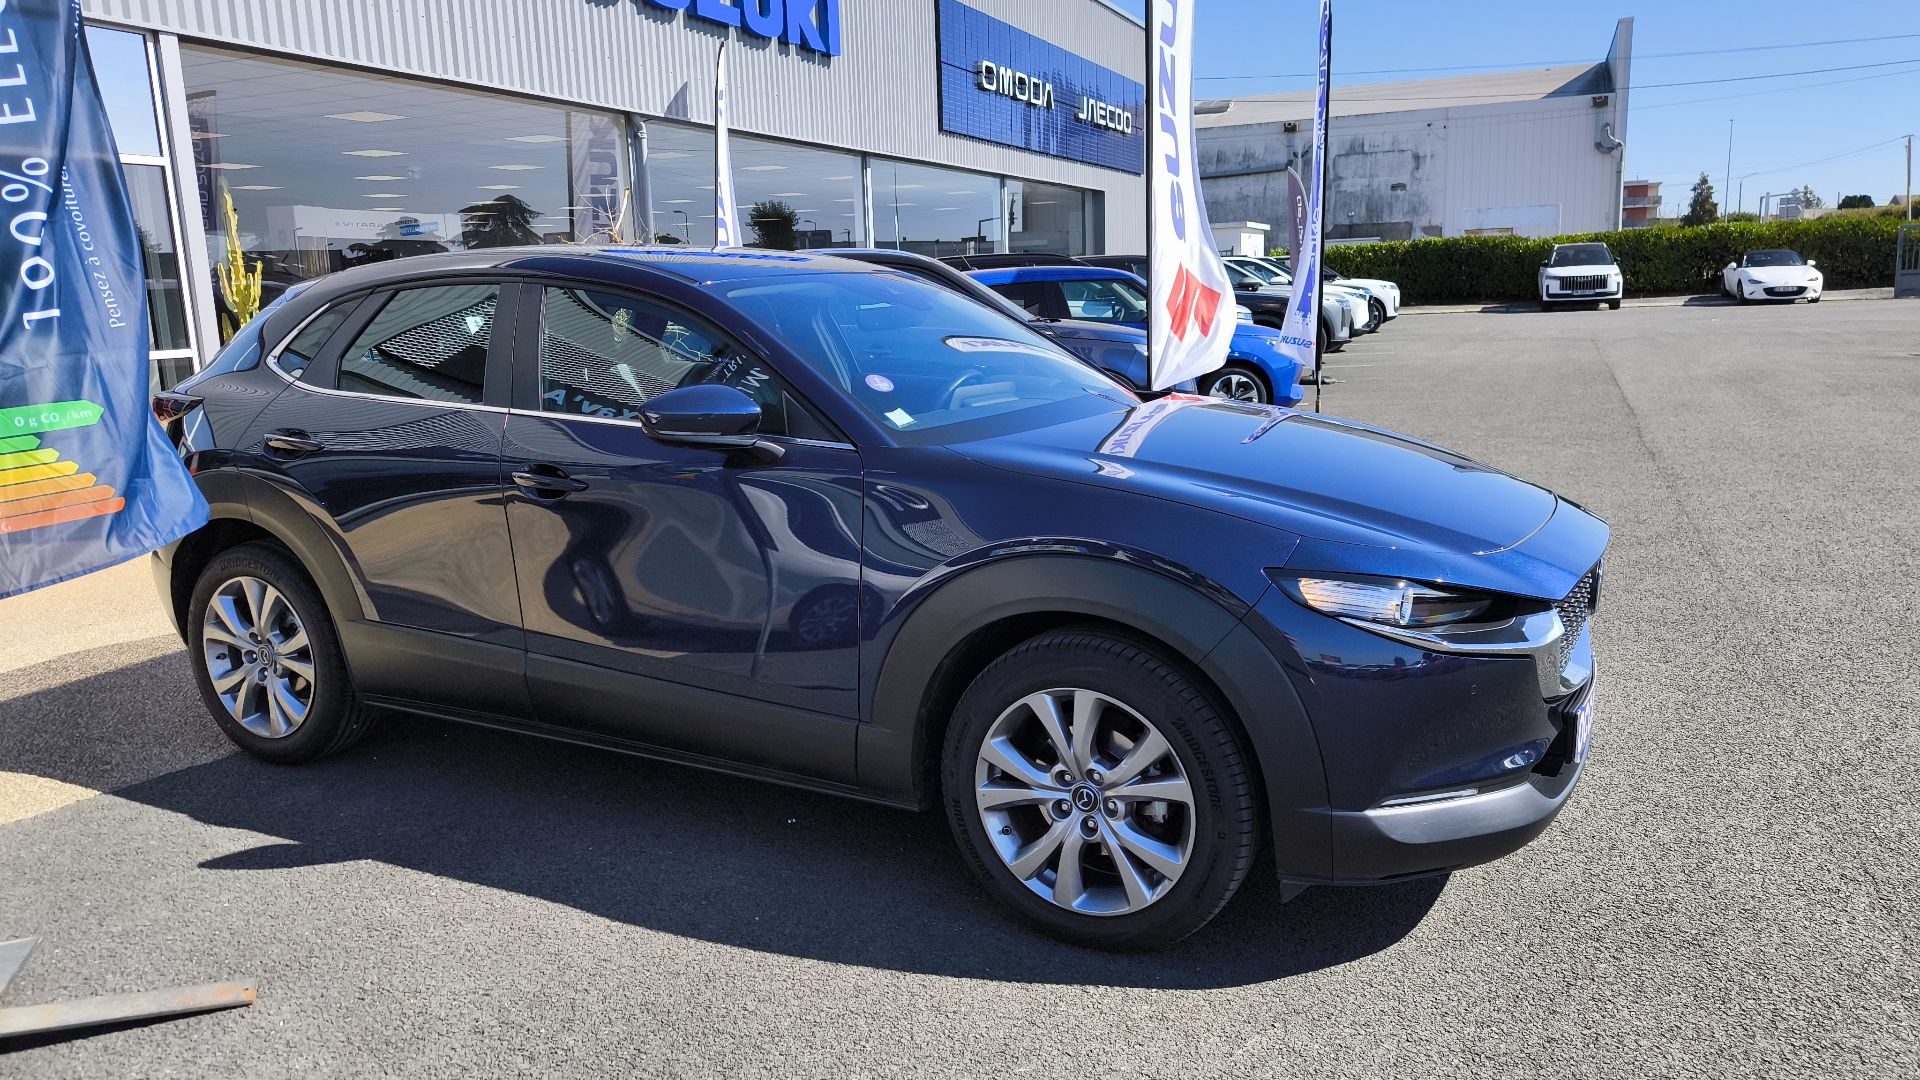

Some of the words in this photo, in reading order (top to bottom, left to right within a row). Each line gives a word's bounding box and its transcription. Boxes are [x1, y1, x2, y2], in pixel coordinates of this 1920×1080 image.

[982, 60, 1055, 110] OMODA
[1078, 95, 1132, 134] JAECOO
[61, 166, 96, 251] covoiture
[0, 157, 61, 329] 100%
[84, 256, 101, 266] à
[94, 271, 127, 328] pensez
[14, 416, 25, 427] 0
[28, 417, 38, 428] g
